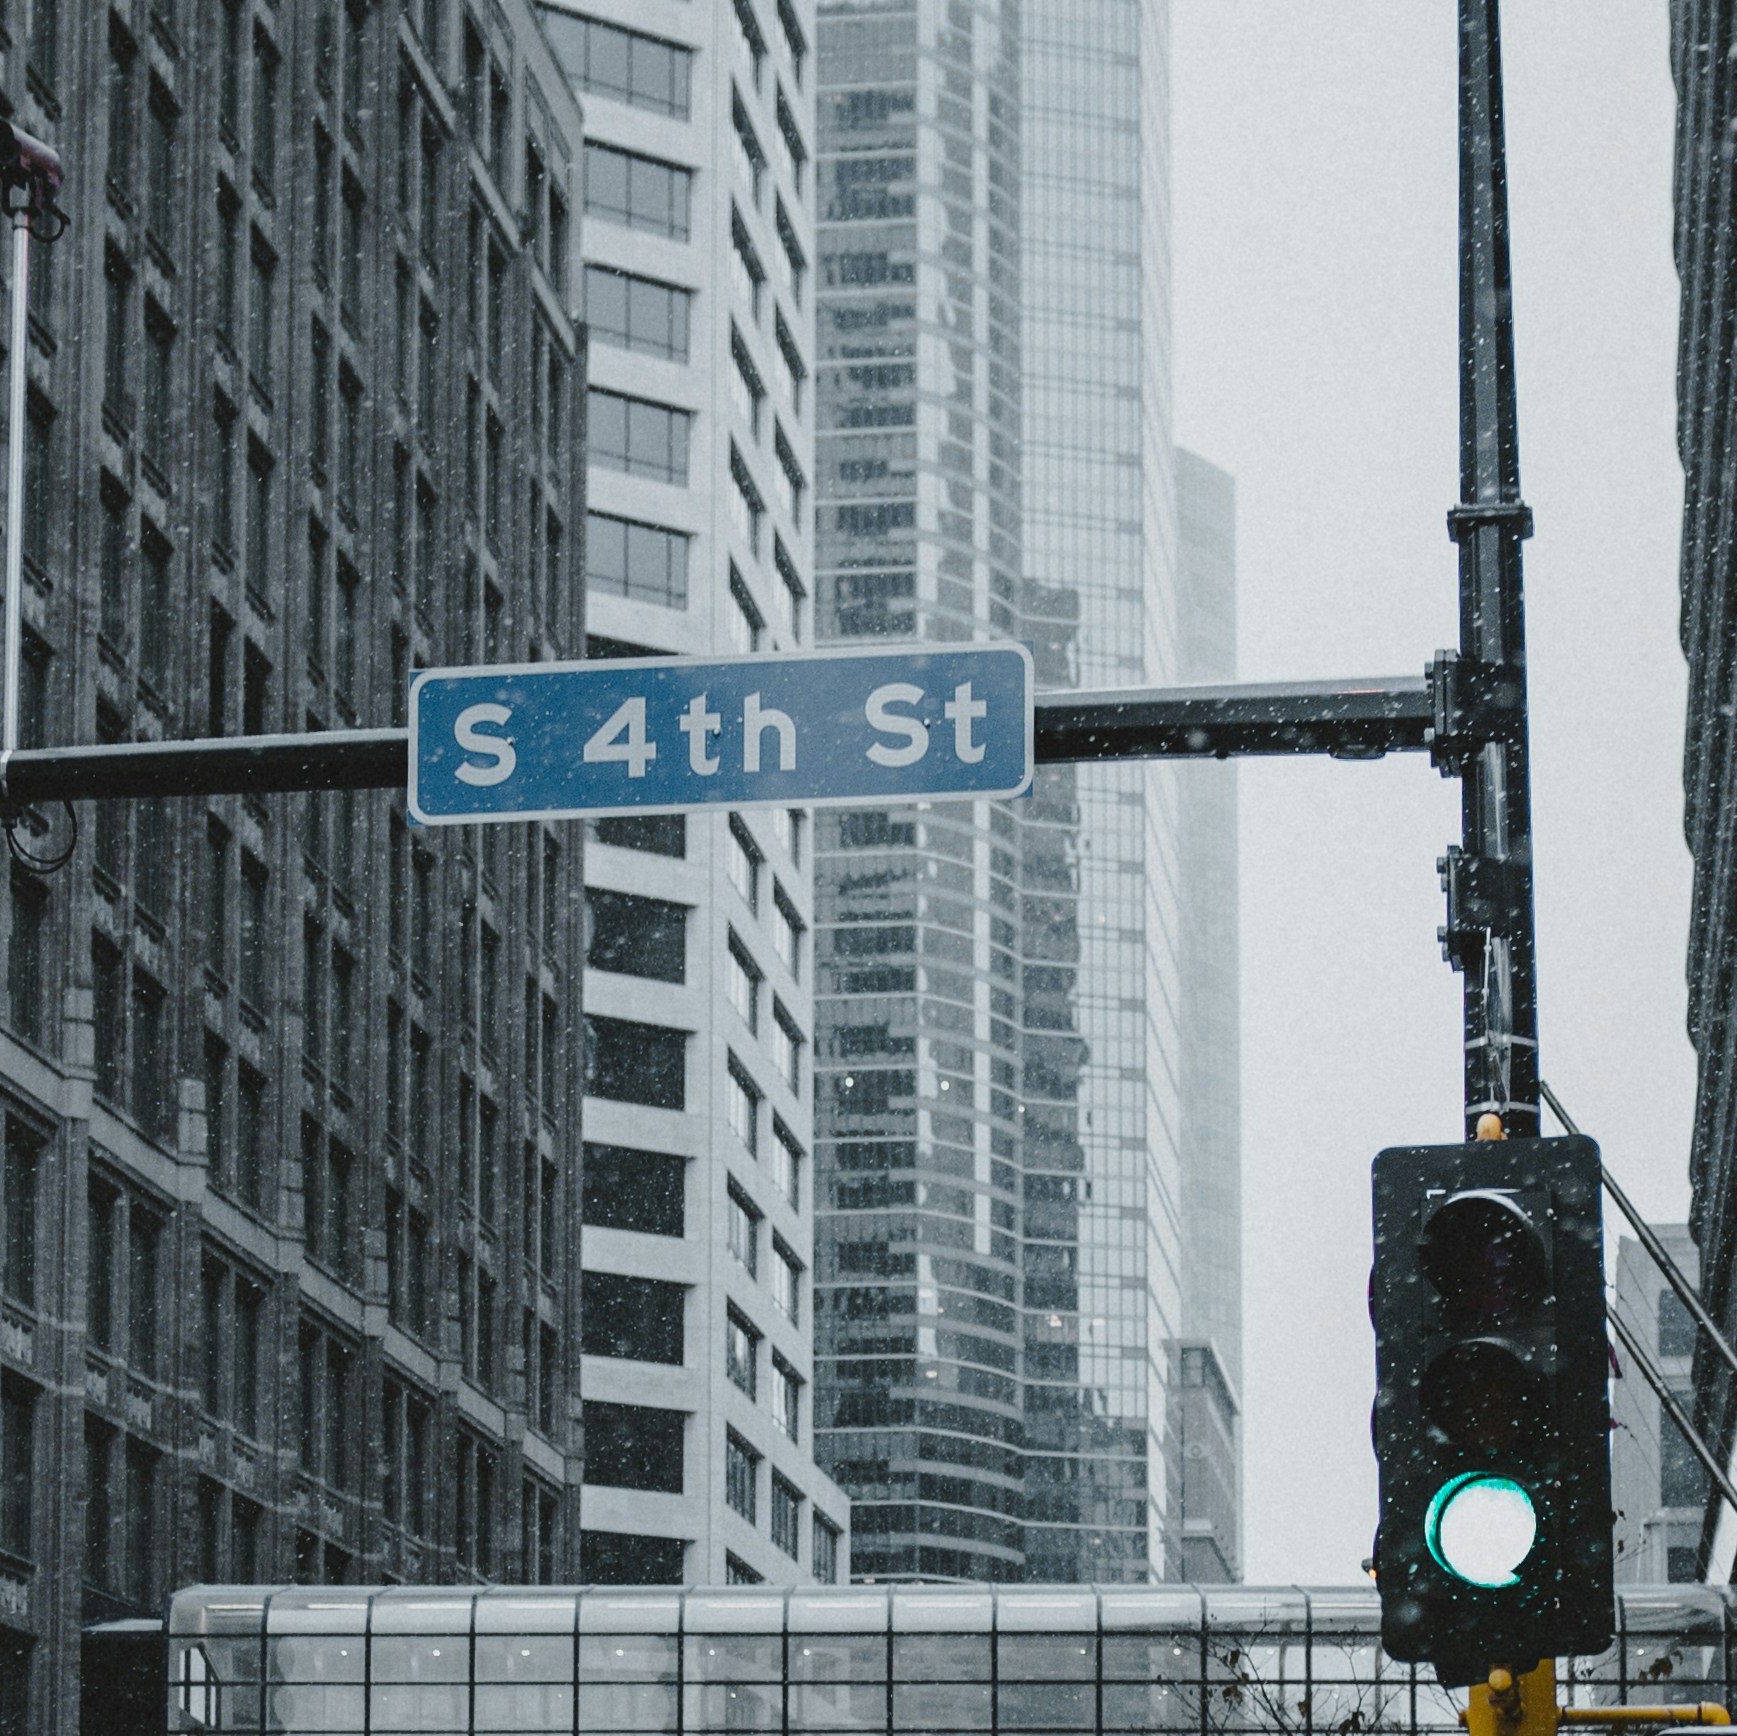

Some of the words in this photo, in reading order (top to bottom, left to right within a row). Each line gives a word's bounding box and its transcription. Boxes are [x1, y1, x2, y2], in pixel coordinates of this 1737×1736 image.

[454, 703, 517, 787] S
[583, 691, 797, 777] 4th
[864, 681, 987, 768] St
